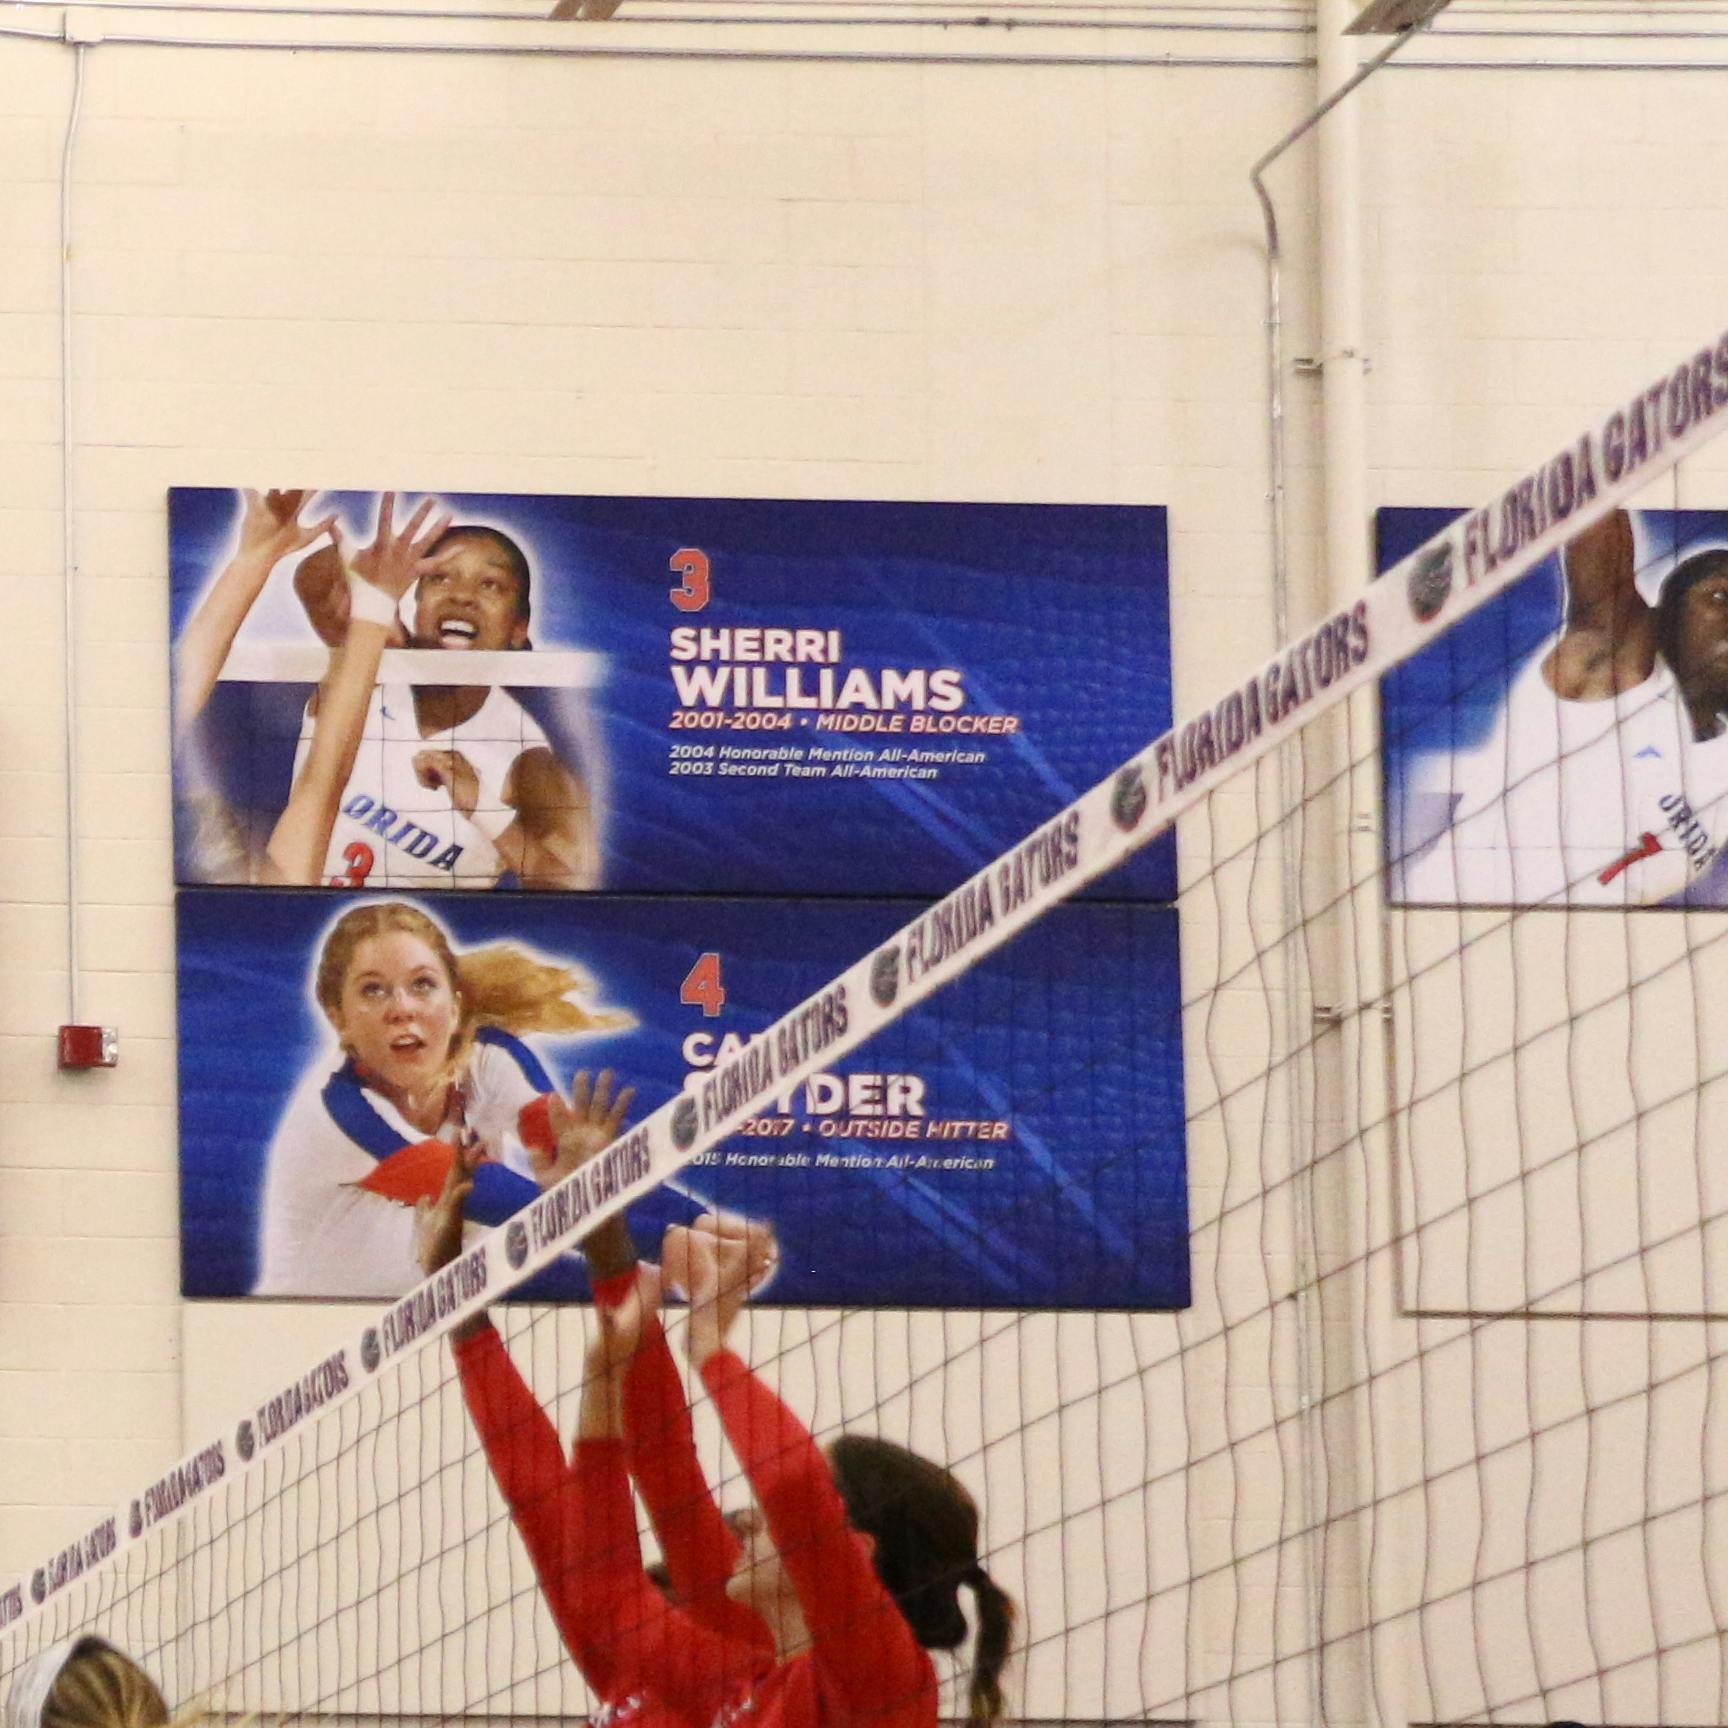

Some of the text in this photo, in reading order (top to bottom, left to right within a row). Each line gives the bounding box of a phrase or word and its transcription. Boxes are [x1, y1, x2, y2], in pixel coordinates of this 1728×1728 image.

[669, 547, 711, 612] 3
[669, 627, 841, 663] SHERRI
[670, 665, 965, 712] WILLIAMS
[669, 711, 1019, 735] 2001-2004 MIDDLE BLOCKER
[669, 745, 986, 764] 2004 Honorable Mention All-American
[669, 762, 937, 780] 2003 Second Team All-American
[343, 793, 464, 872] ORIDA
[680, 952, 725, 1017] 4
[819, 1119, 924, 1140] OUTSIDE
[926, 1121, 1009, 1140] HITTER
